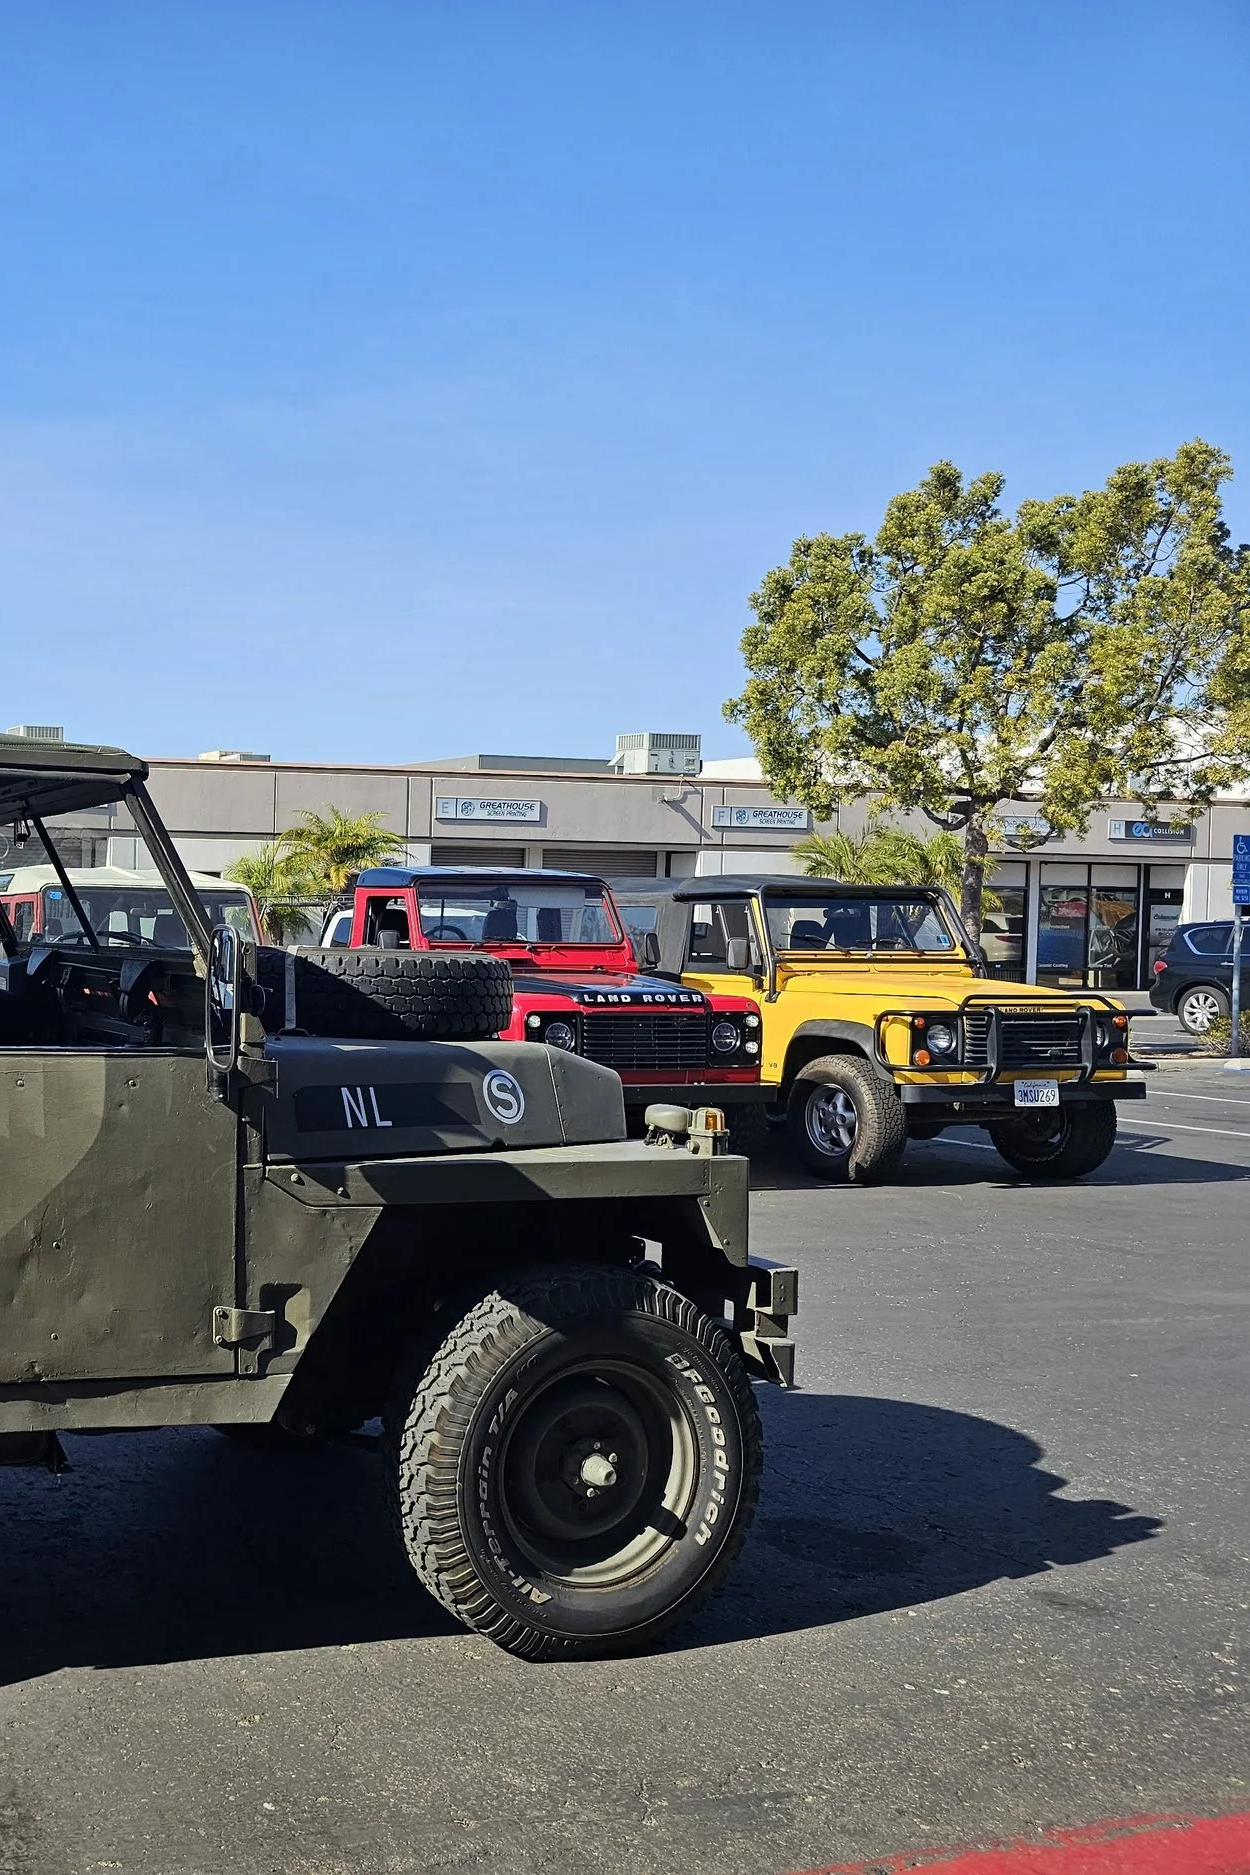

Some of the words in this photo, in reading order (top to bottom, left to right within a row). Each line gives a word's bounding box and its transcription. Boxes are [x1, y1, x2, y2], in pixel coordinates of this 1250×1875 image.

[441, 801, 449, 813] E
[479, 801, 536, 811] GREATHOUSE
[717, 810, 726, 822] F
[752, 810, 804, 819] GREATHOUSE
[1113, 823, 1121, 834] H
[1164, 891, 1171, 899] H
[583, 994, 632, 1003] LAND
[642, 994, 703, 1003] ROVER
[489, 1074, 519, 1118] S
[1017, 1089, 1056, 1103] 3MSU269
[340, 1086, 393, 1128] NL
[488, 1387, 519, 1436] T/A
[664, 1352, 730, 1546] BFGoodrich
[478, 1446, 552, 1604] All-Terrain
